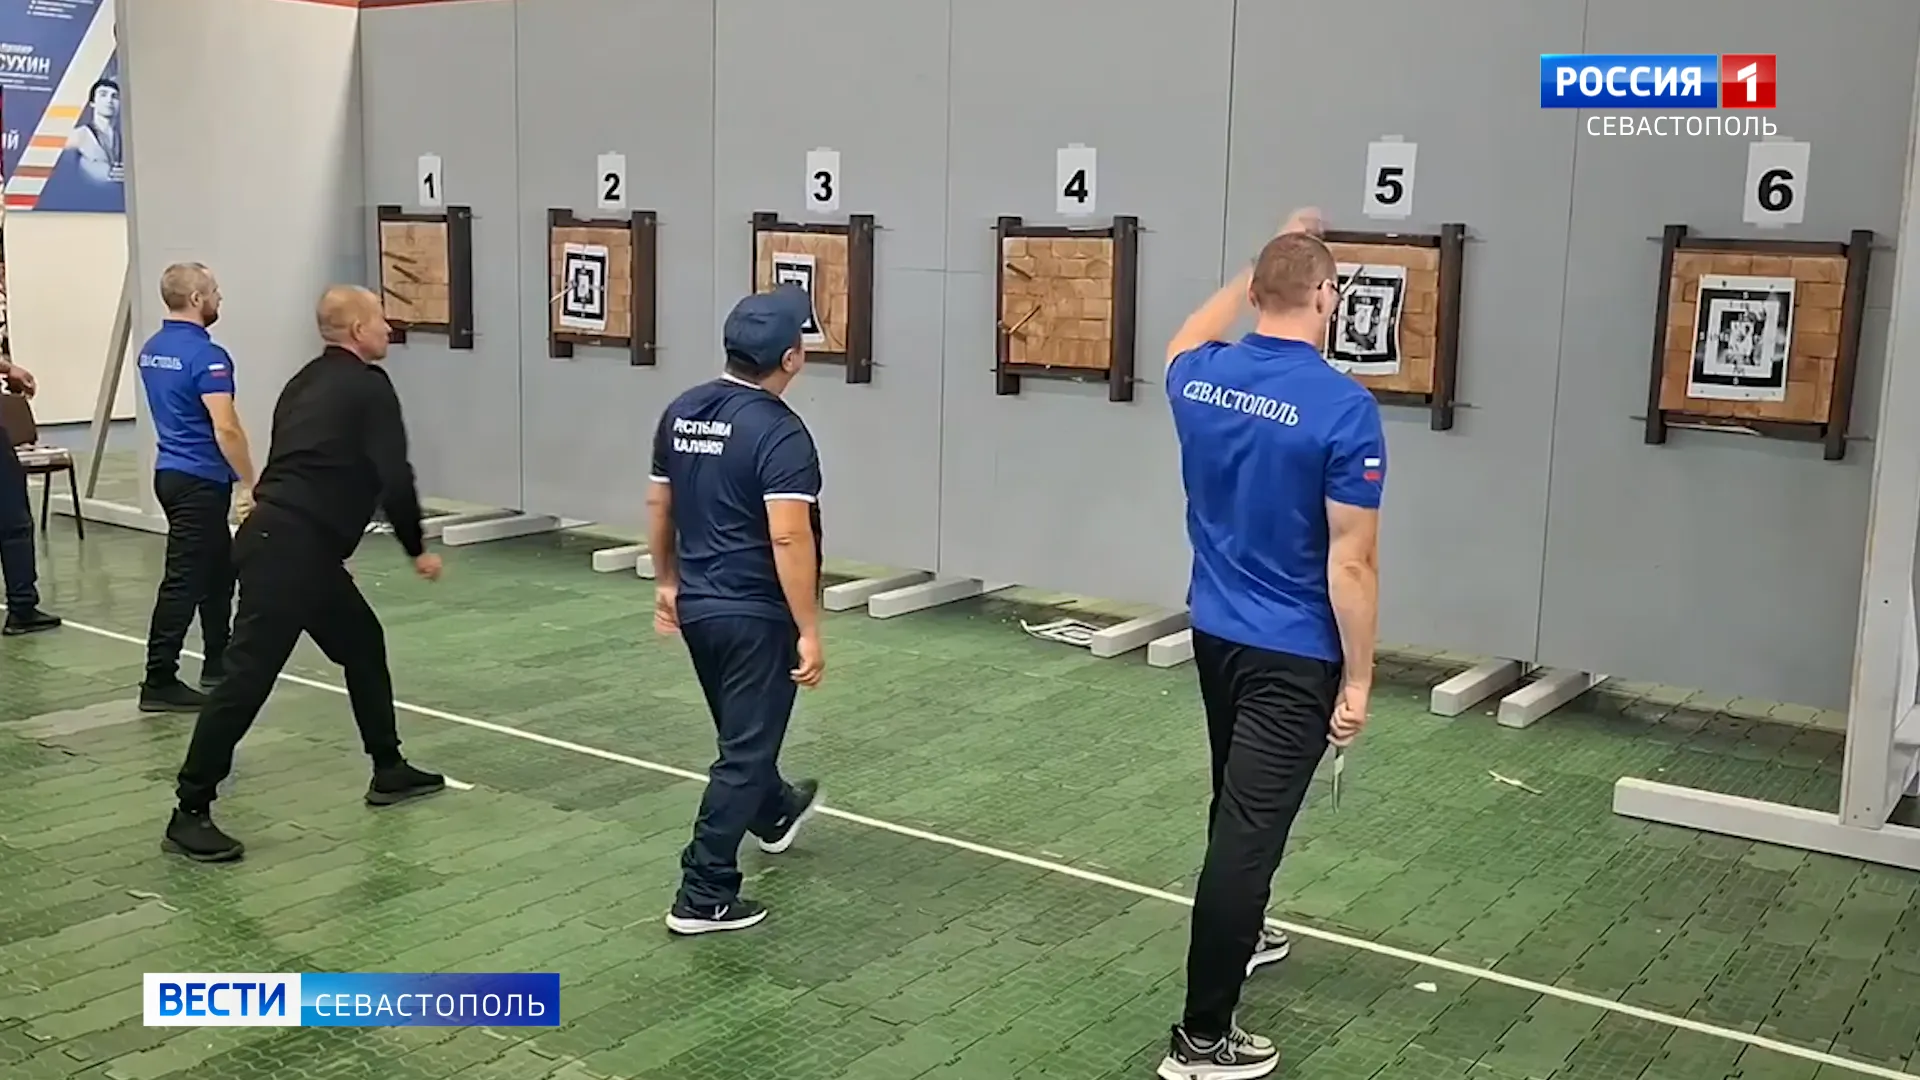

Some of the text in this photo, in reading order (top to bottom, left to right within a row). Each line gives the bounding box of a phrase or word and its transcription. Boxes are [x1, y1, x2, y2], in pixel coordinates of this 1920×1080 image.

[424, 172, 434, 199] 1
[604, 173, 620, 201] 2
[813, 171, 833, 202] 3
[1064, 169, 1088, 204] 4
[1375, 167, 1404, 205] 5
[1758, 169, 1794, 212] 6
[1183, 380, 1299, 426] СЕВАСТОПОЛЬ
